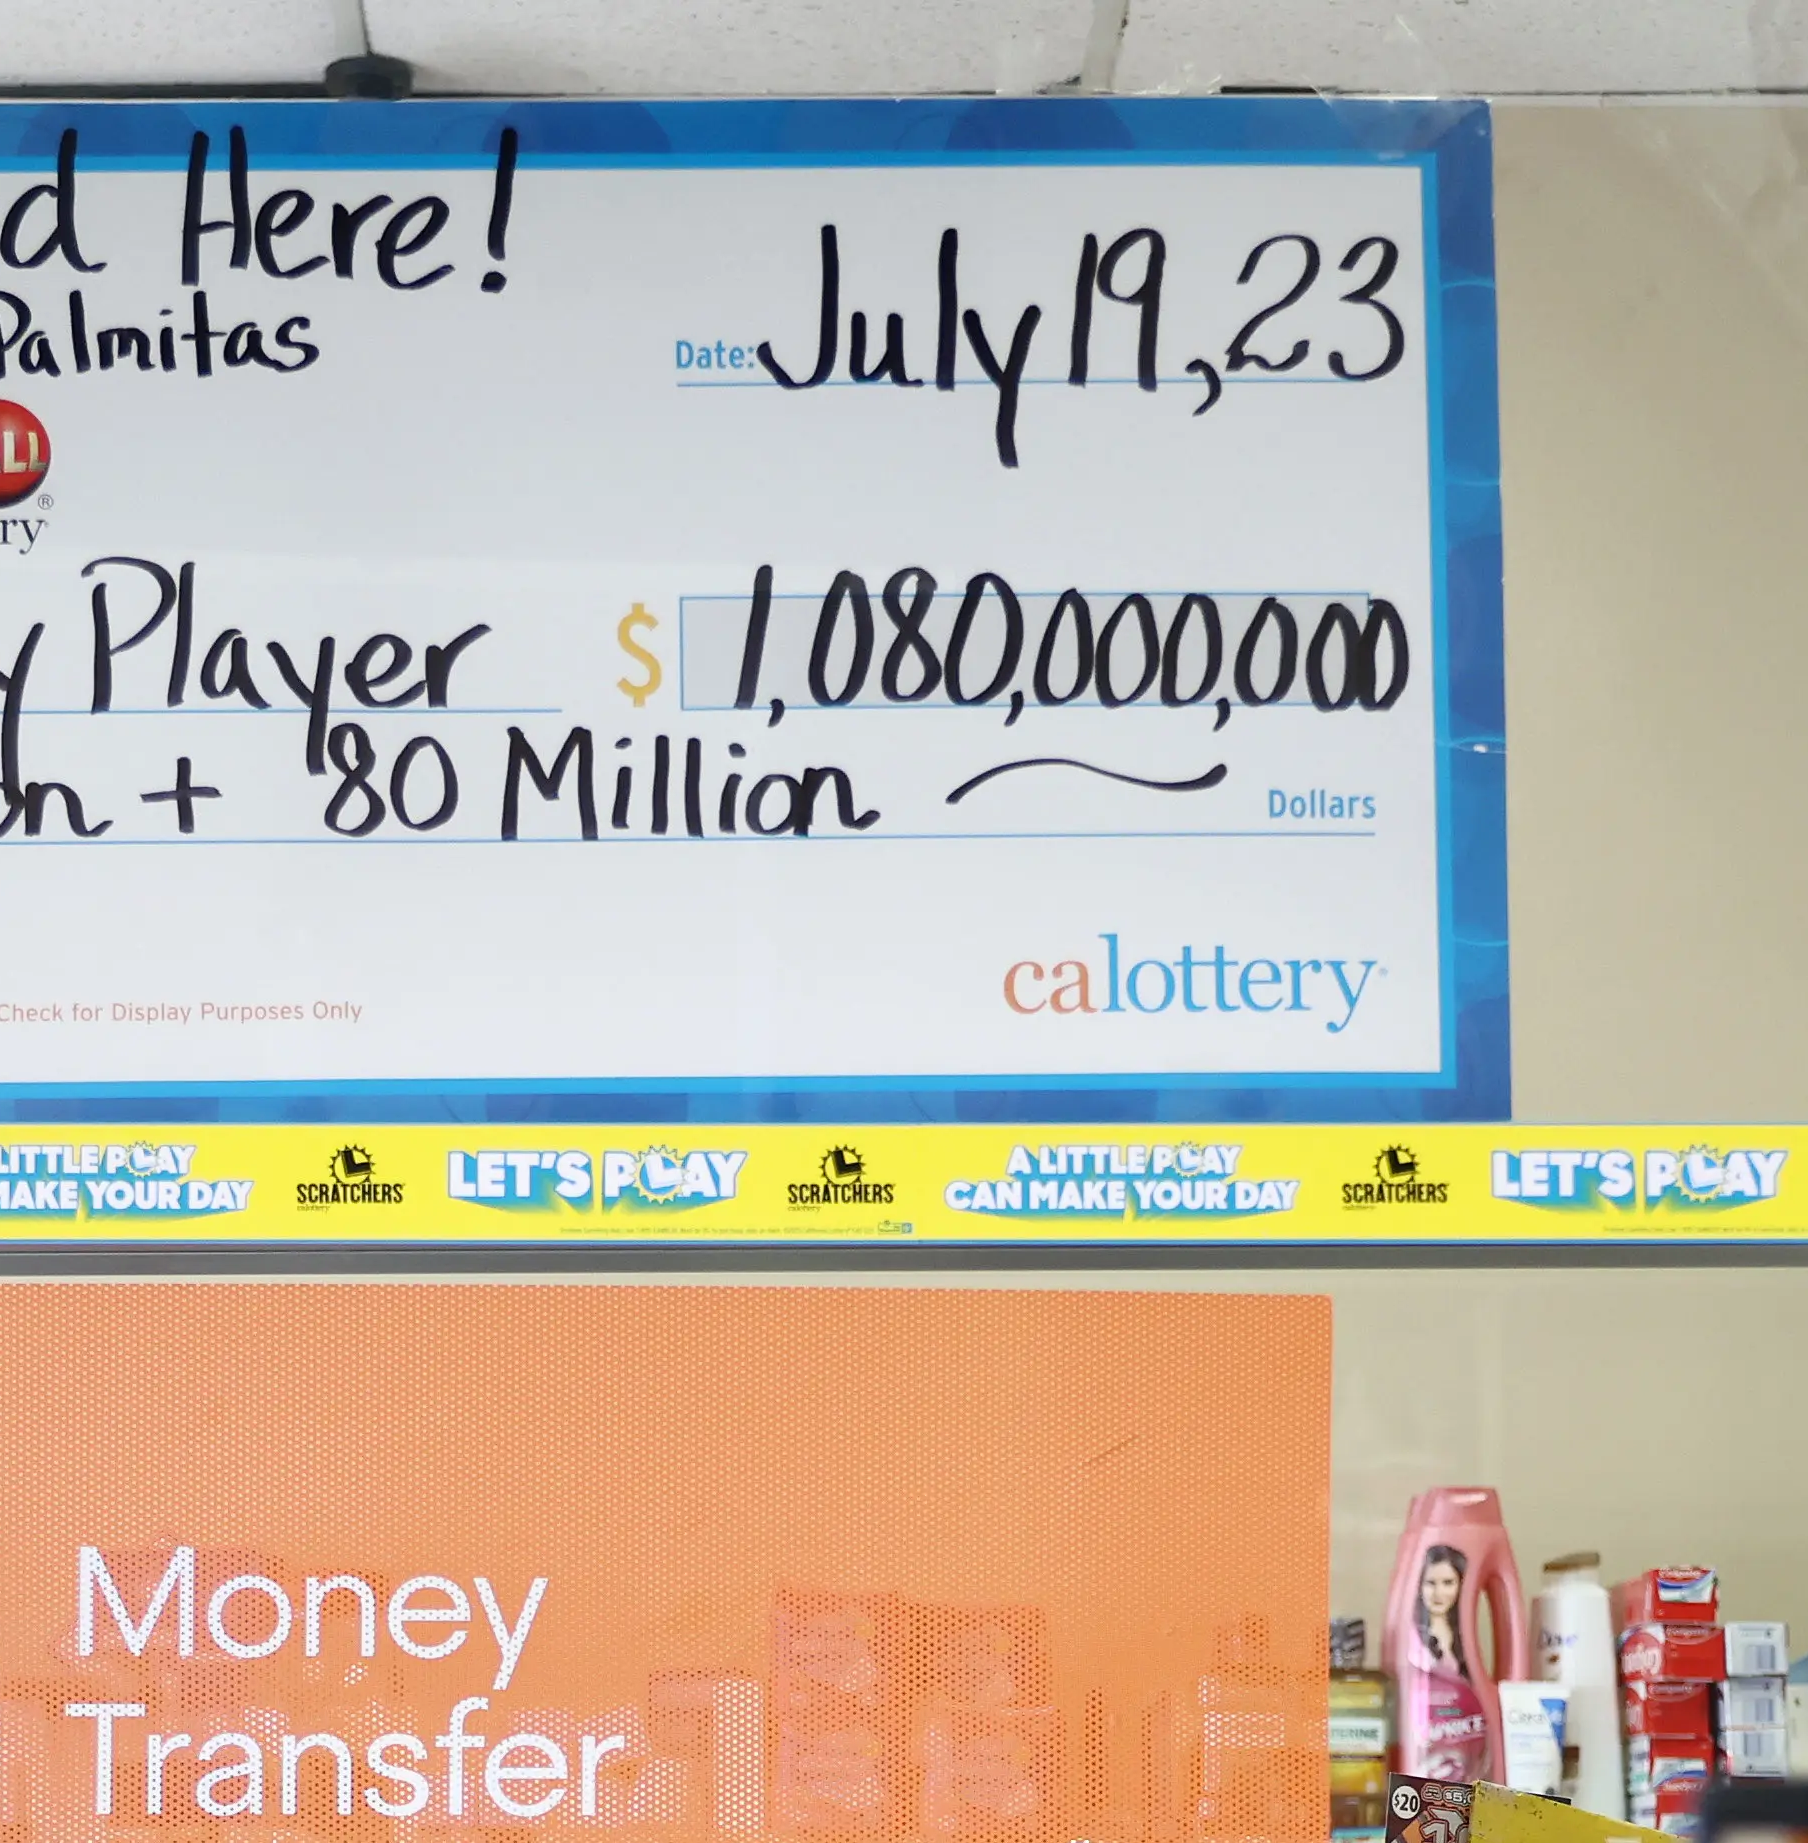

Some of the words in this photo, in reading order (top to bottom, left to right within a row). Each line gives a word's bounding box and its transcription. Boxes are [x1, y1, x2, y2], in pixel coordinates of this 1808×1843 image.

[181, 123, 520, 294] Here!
[676, 340, 755, 372] Date:
[756, 224, 1041, 468] July
[78, 556, 492, 776] Player
[616, 602, 663, 708] $
[734, 564, 1410, 728] 1,080,000,000
[141, 757, 223, 833] +
[321, 724, 459, 838] 80
[502, 726, 881, 841] Million
[1268, 789, 1377, 822] Dollars
[72, 1003, 103, 1022] for
[112, 1002, 191, 1025] Display
[201, 1001, 304, 1024] Purposes
[313, 1001, 363, 1024] Only
[1003, 934, 1379, 1034] calottery
[83, 1178, 188, 1212] YOUR
[190, 1178, 254, 1211] DAY
[103, 1140, 196, 1178] PLAY
[79, 1545, 548, 1689] Money
[65, 1697, 625, 1817] Transfer
